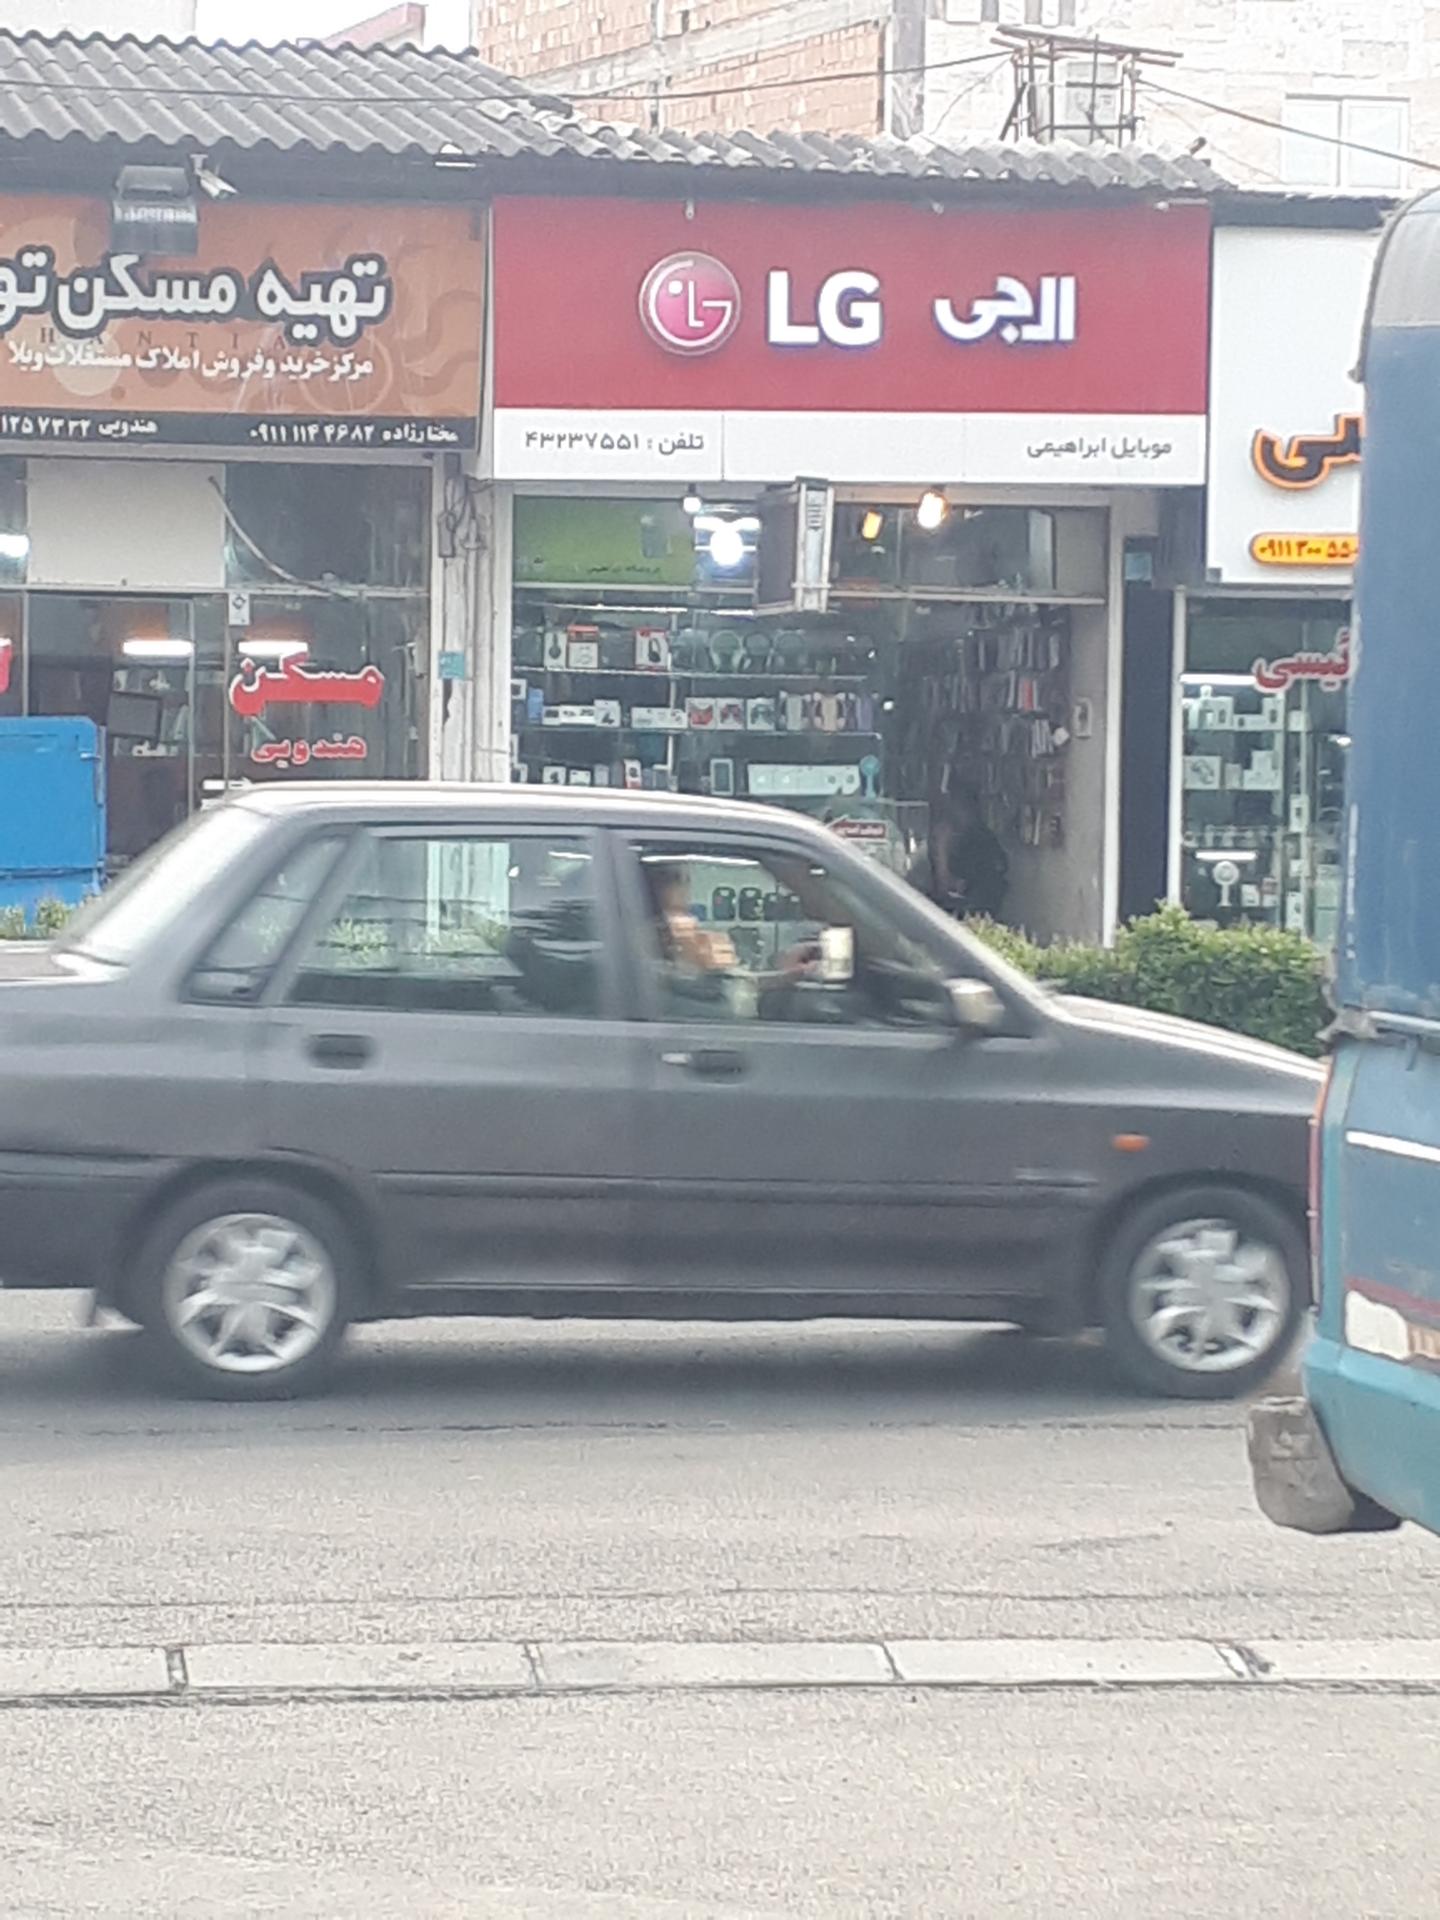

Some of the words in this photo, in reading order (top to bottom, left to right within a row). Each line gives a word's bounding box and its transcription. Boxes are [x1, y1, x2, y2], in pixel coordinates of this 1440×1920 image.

[58, 253, 237, 330] مسکن
[257, 260, 386, 338] تهیه
[768, 270, 881, 346] LG
[135, 347, 200, 370] املاک
[280, 351, 331, 380] خرید
[327, 352, 374, 382] مرکز
[525, 431, 639, 450] ۴۳۲۳۷۵۵۱
[1111, 437, 1172, 460] موبایل
[229, 650, 384, 716] مسکن
